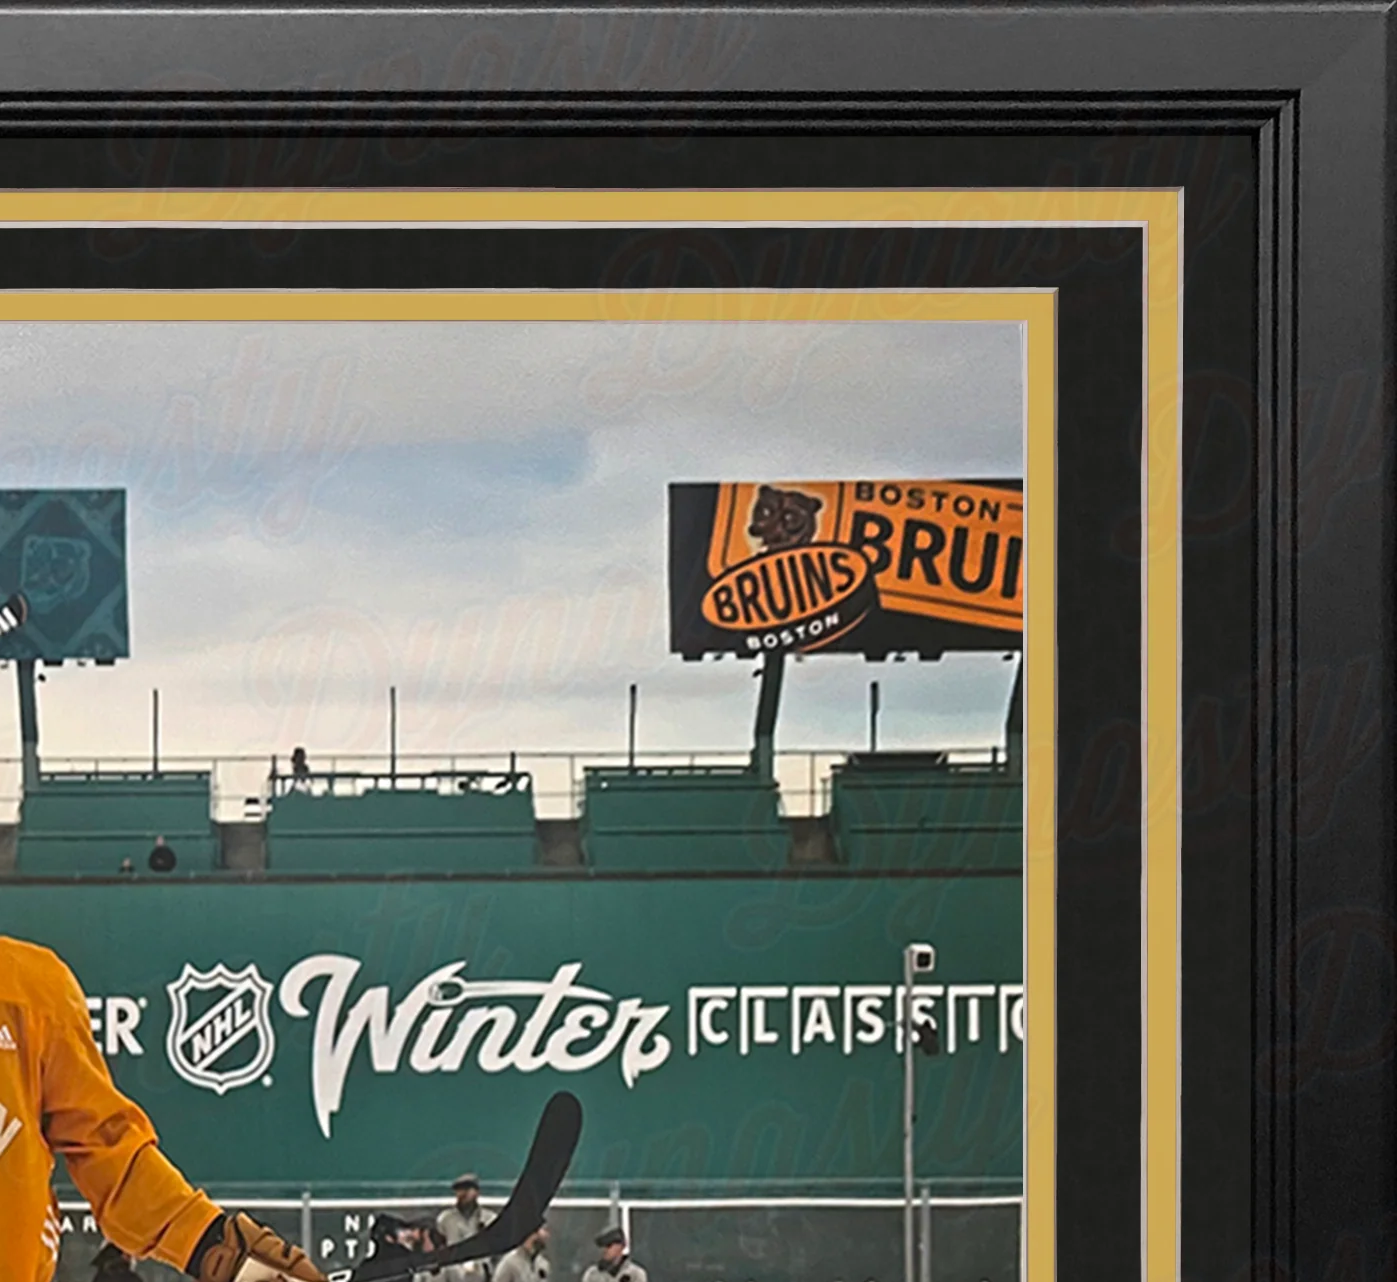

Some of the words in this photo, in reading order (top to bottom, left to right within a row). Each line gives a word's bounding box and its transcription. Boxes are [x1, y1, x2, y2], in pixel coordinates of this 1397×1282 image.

[855, 481, 1001, 522] BOSTON
[713, 551, 856, 626] BRUINS
[746, 612, 841, 651] BOSTON
[190, 1001, 254, 1064] NHL
[279, 954, 671, 1139] Winter
